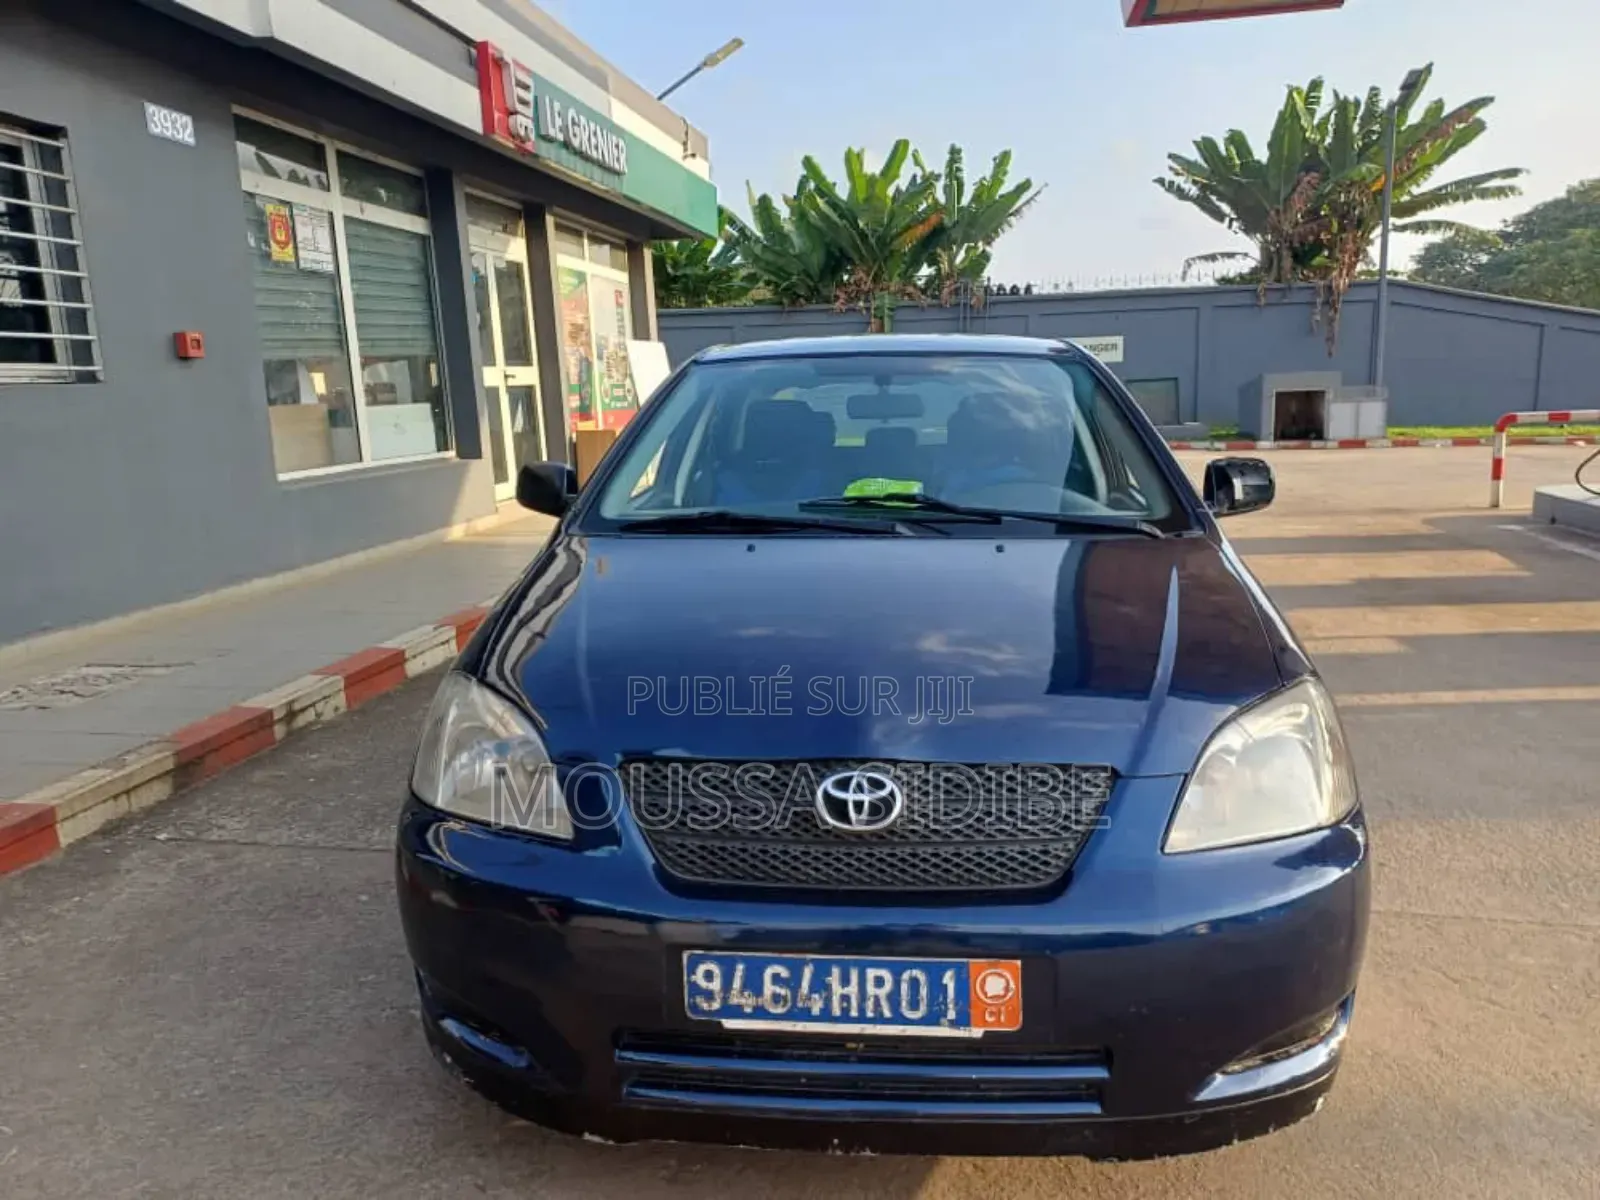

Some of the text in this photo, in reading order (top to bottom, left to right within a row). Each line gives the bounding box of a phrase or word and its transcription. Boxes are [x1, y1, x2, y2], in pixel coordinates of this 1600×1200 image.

[149, 104, 195, 143] 3932
[545, 95, 564, 142] LE
[567, 107, 628, 174] GRENIER
[690, 960, 958, 1021] 9464HR01
